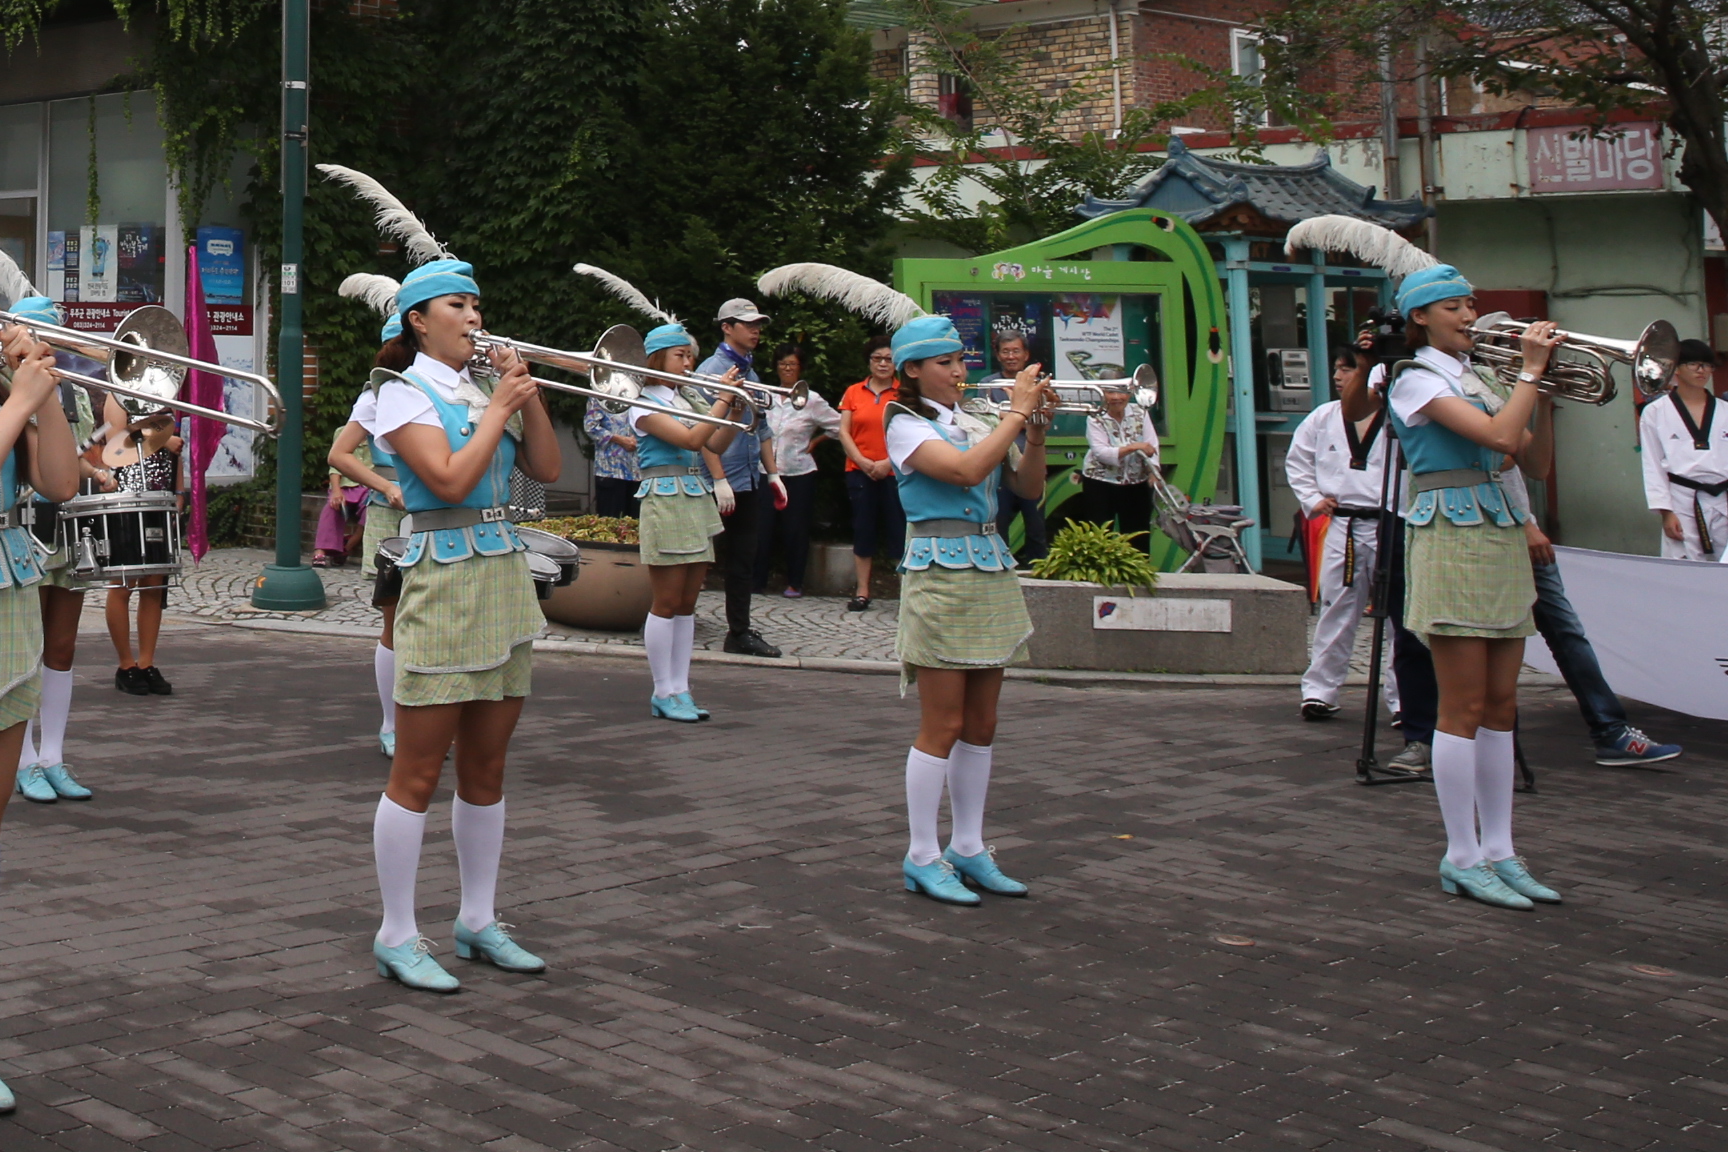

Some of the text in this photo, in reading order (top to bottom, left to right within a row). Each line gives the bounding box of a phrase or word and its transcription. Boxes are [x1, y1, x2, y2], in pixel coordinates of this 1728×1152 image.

[1534, 128, 1656, 183] 신발마당
[1031, 265, 1053, 279] 마을
[70, 308, 111, 319] 무주군 관광안내소
[213, 311, 244, 323] 관광안내소
